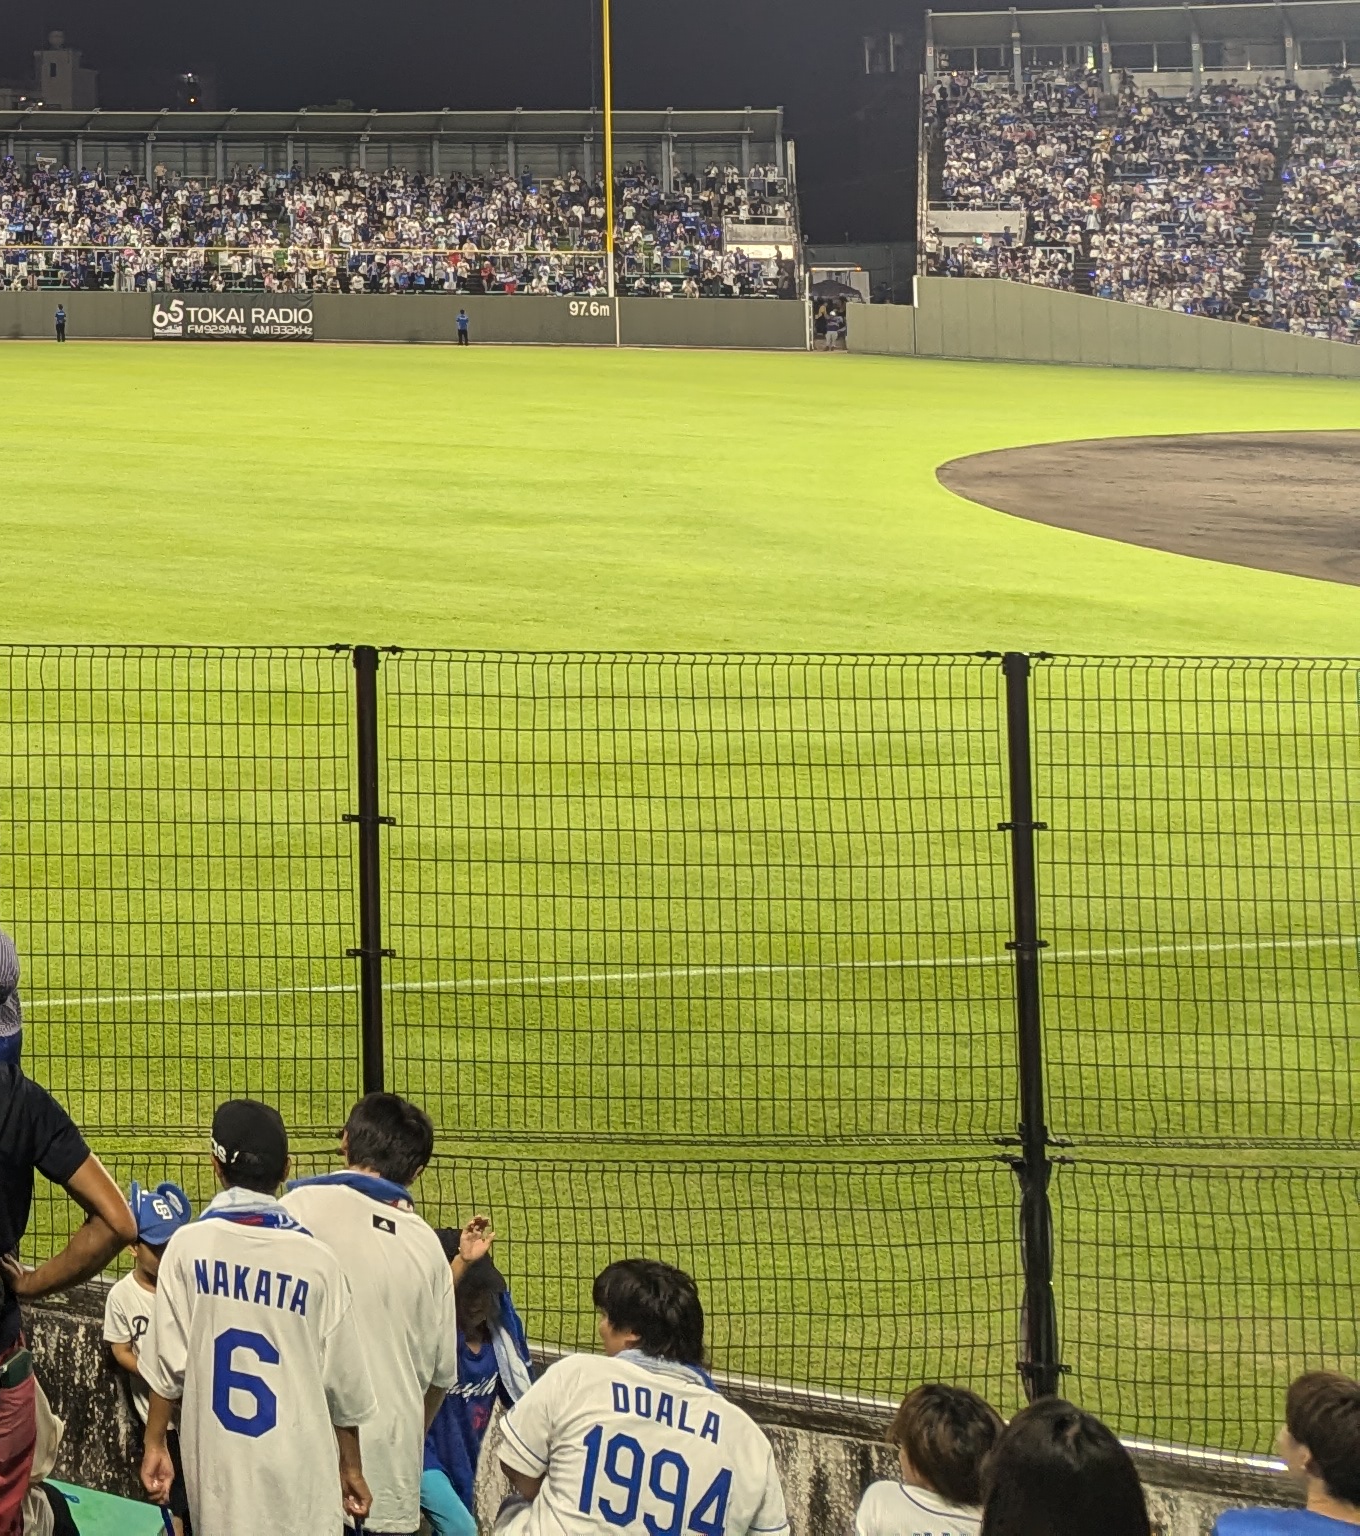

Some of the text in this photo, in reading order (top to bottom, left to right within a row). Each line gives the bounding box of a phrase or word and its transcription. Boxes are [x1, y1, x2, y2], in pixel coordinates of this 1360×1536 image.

[152, 298, 313, 327] 65 TOKAI RADIO
[569, 301, 610, 317] 97.6m
[194, 1258, 310, 1317] NAKATA
[211, 1326, 281, 1440] 6
[611, 1381, 721, 1446] DOALA
[578, 1423, 733, 1536] 1994
